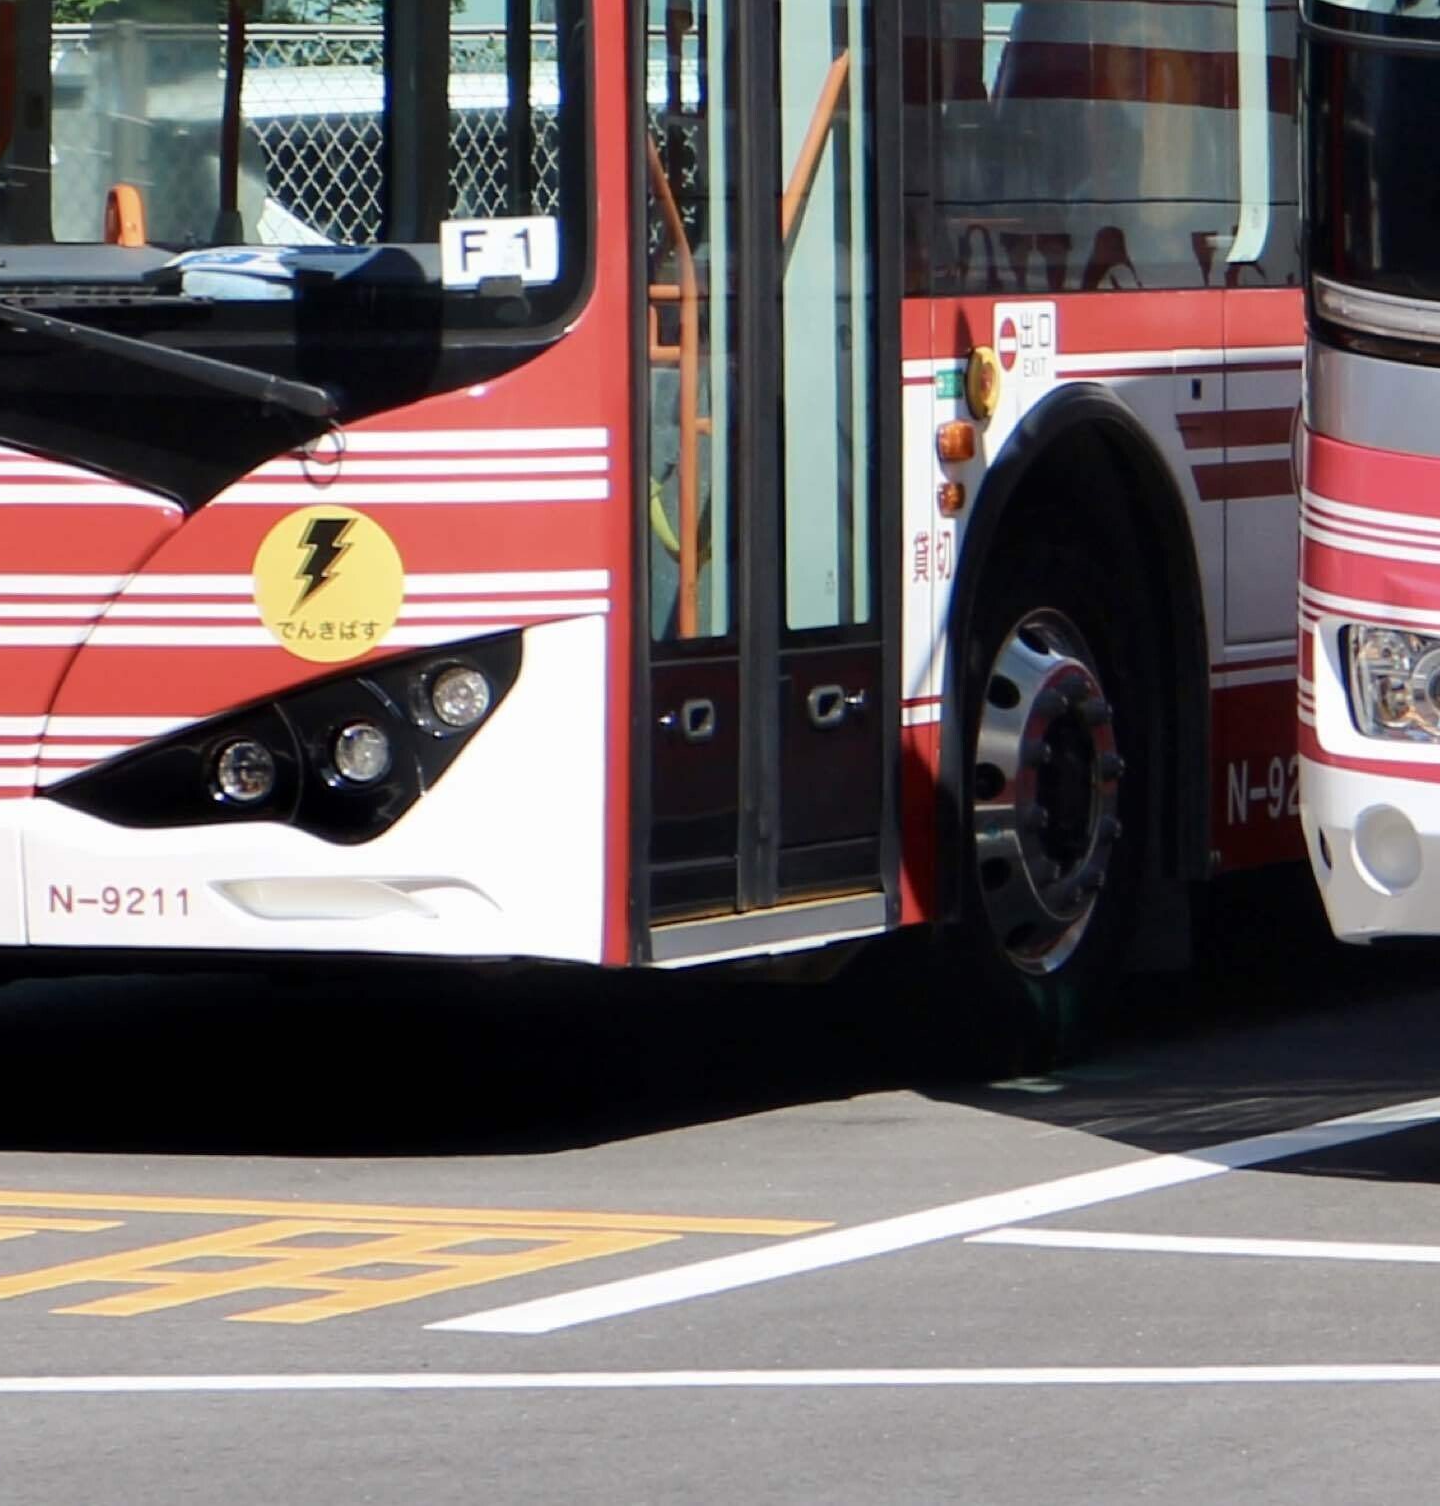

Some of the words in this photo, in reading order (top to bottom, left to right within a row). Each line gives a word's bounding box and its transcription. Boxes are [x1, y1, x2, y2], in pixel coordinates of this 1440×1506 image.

[1020, 312, 1051, 349] 出口
[1023, 357, 1048, 378] EXIT
[912, 530, 953, 583] 貸切
[278, 620, 382, 642] でんきばす
[48, 884, 191, 917] N-9211
